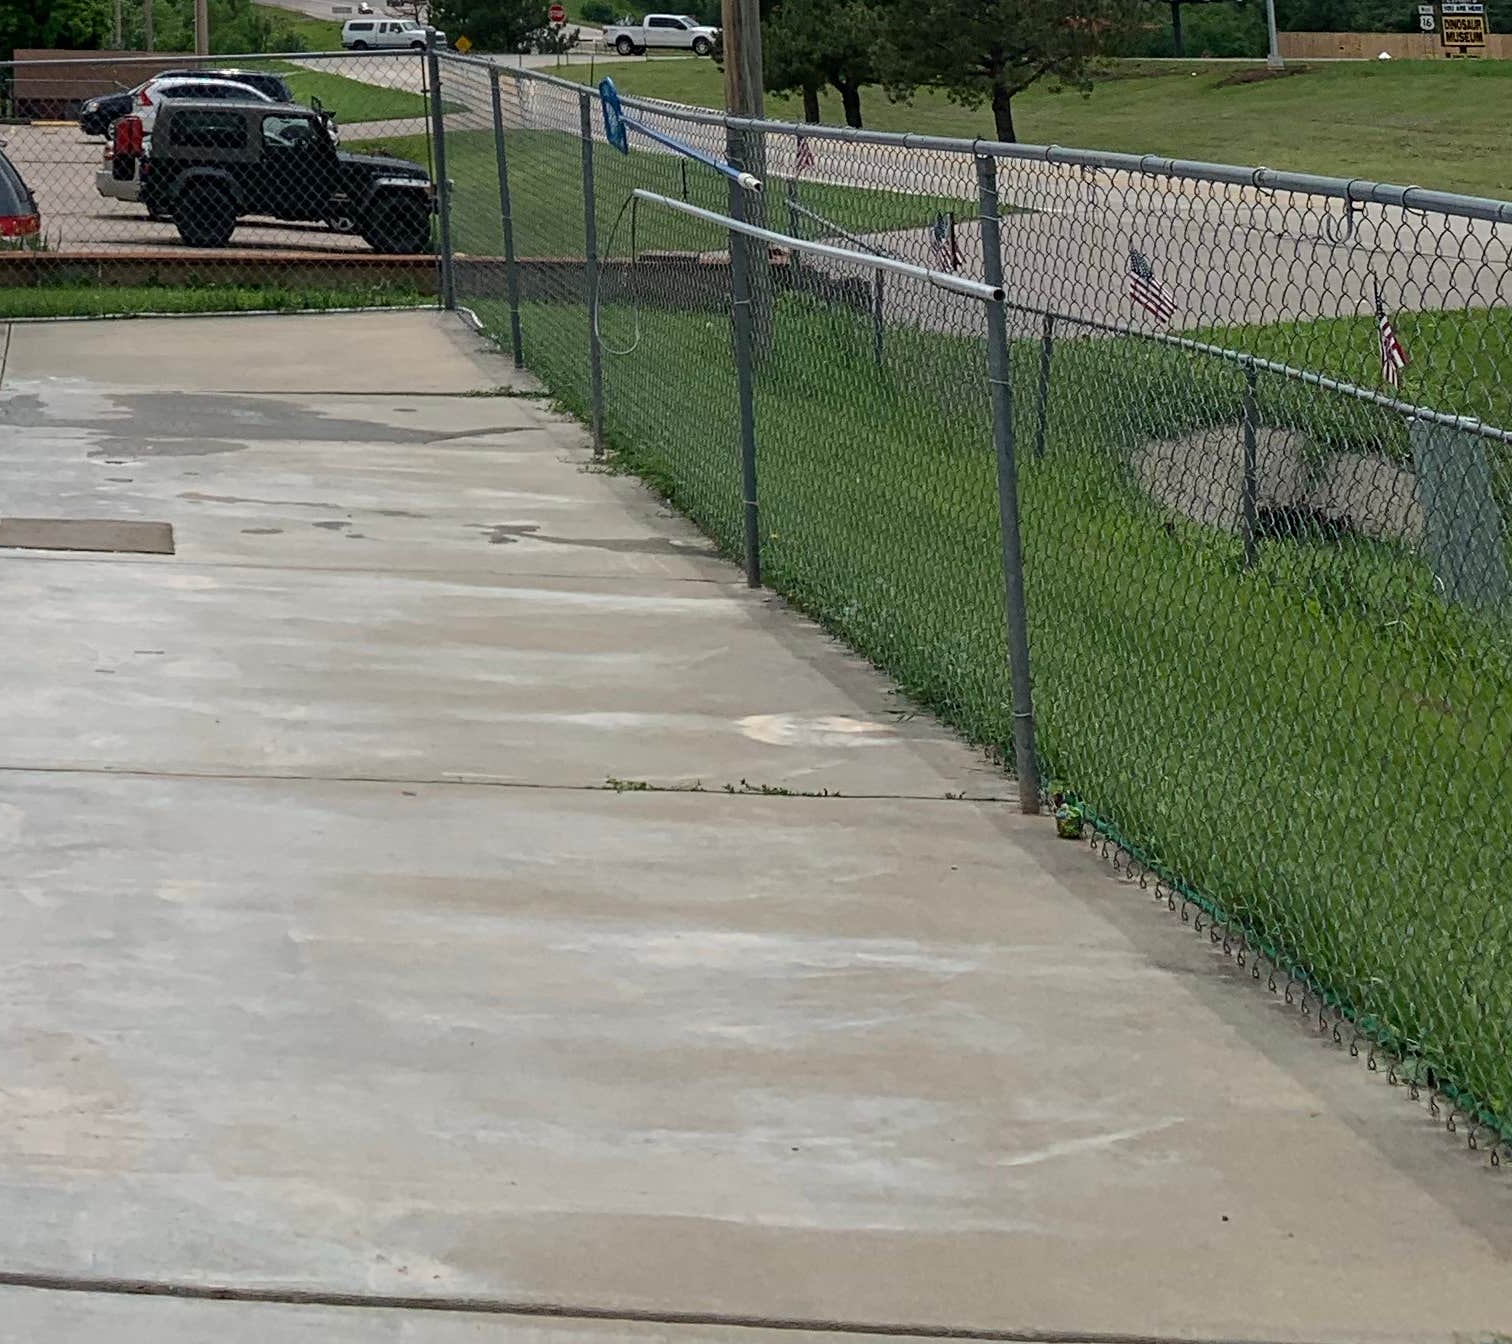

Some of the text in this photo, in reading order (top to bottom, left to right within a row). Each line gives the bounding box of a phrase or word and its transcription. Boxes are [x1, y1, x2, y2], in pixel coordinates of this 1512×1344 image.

[1423, 17, 1433, 27] 16
[1444, 18, 1482, 30] DINOSAUR
[1446, 31, 1483, 43] MUSEUM
